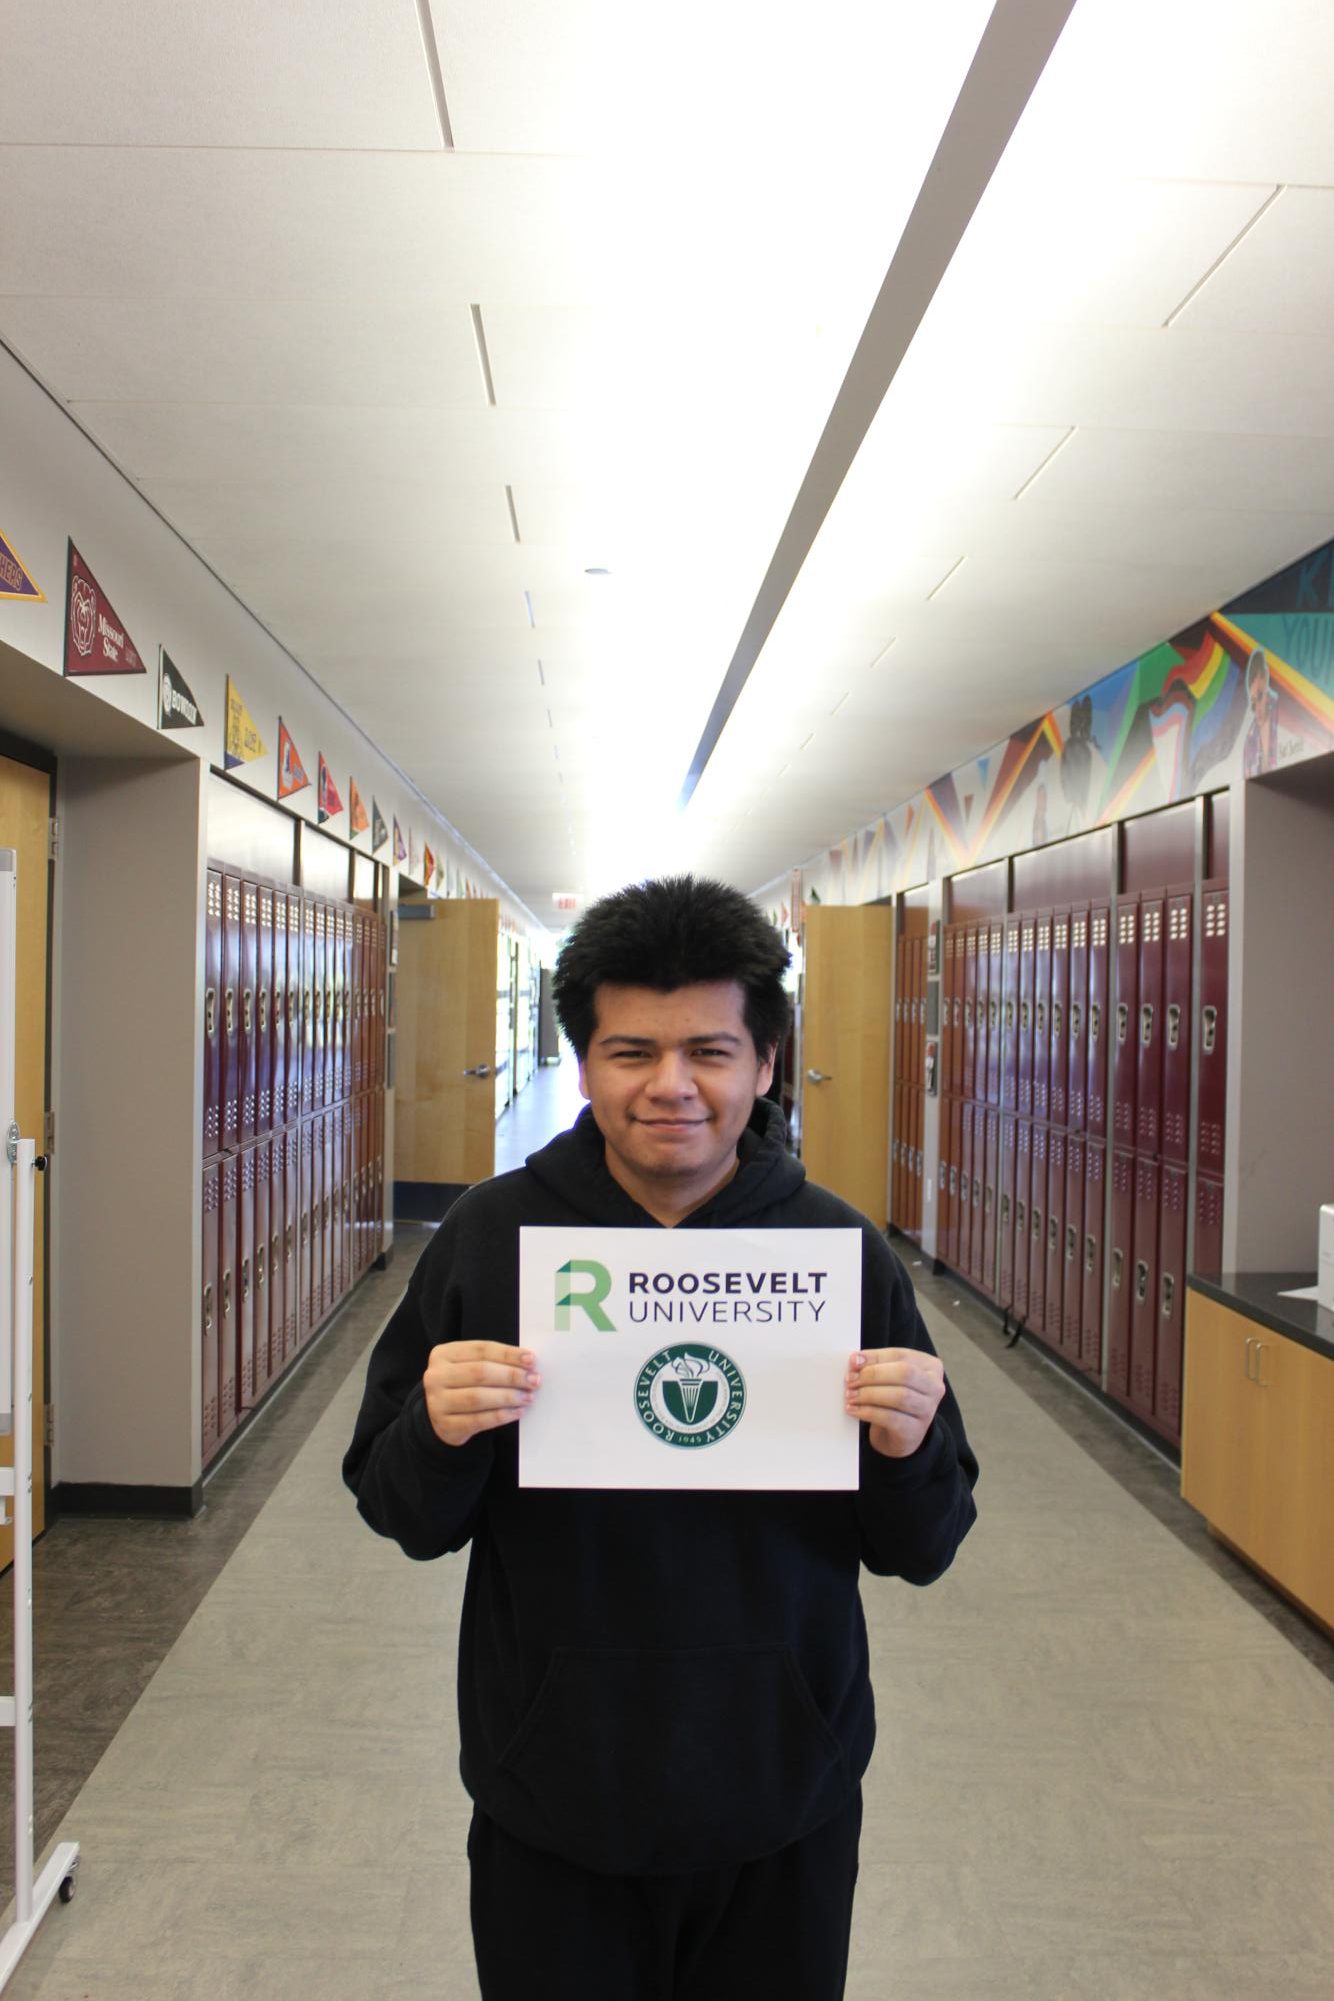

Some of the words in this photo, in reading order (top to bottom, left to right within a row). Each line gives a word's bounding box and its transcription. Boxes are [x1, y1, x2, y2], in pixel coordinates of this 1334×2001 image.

[628, 1272, 828, 1295] ROOSEVELT
[629, 1300, 827, 1323] UNIVERSITY
[638, 1350, 675, 1442] ROOSEVELT
[706, 1350, 743, 1443] UNIVERSITY
